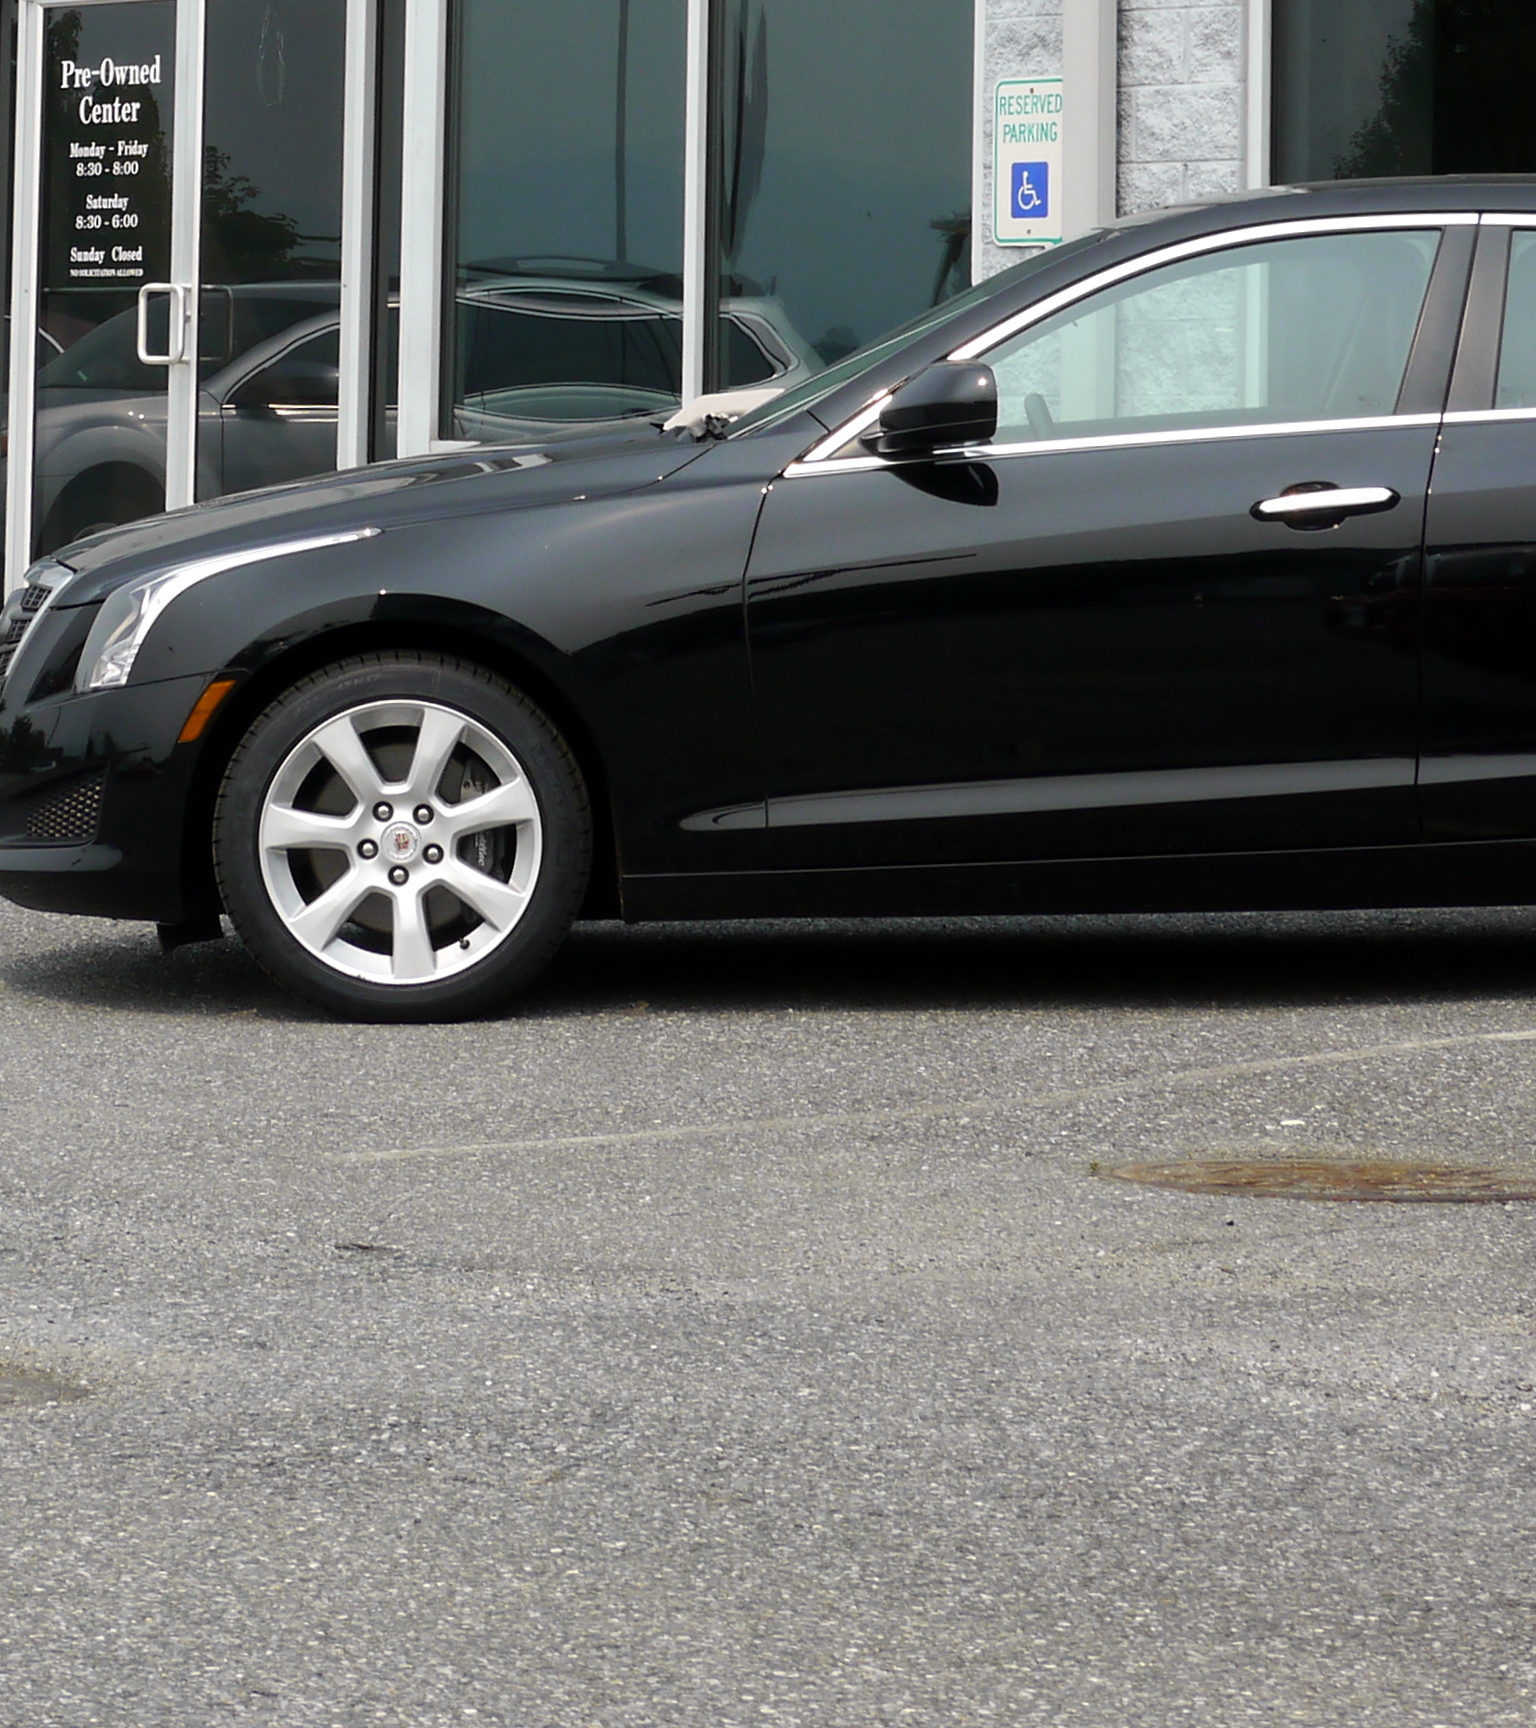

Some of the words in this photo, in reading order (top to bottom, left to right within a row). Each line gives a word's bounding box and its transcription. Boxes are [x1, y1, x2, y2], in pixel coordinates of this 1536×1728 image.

[60, 54, 162, 89] Pre-Owned
[79, 95, 141, 125] Center
[999, 93, 1063, 116] RESERVED
[1002, 121, 1058, 144] PARKING
[69, 141, 106, 159] Monday
[117, 139, 149, 158] Friday
[76, 162, 103, 177] 8:30
[112, 160, 139, 175] 8:00
[85, 193, 129, 211] Saturday
[75, 214, 102, 230] 8:30
[111, 213, 139, 229] 6:00
[70, 246, 105, 265] Sunday
[111, 245, 143, 262] Closed
